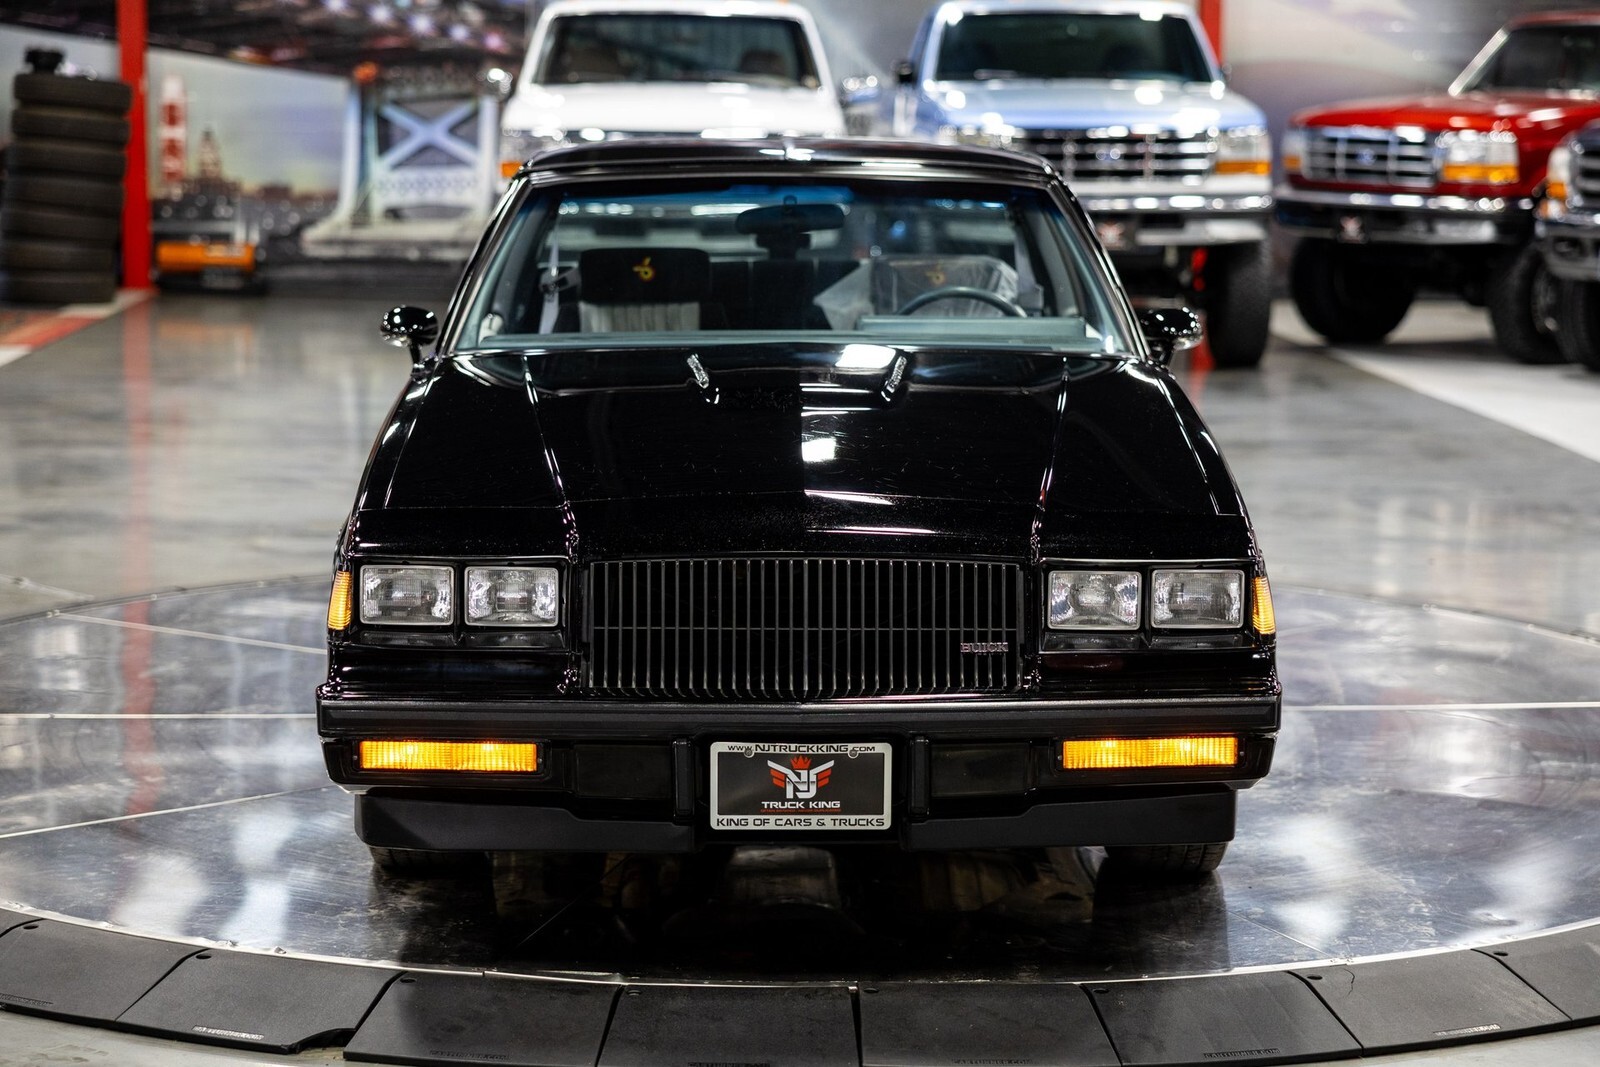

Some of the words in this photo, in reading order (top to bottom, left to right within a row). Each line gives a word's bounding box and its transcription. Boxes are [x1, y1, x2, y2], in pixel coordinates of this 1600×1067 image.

[960, 641, 1009, 653] BUICK
[761, 801, 805, 809] TRUCK
[809, 801, 841, 809] KING
[716, 818, 749, 827] KING
[752, 818, 770, 827] OF
[774, 818, 812, 827] CARS
[816, 818, 826, 827] &
[830, 818, 885, 827] TRUCKS
